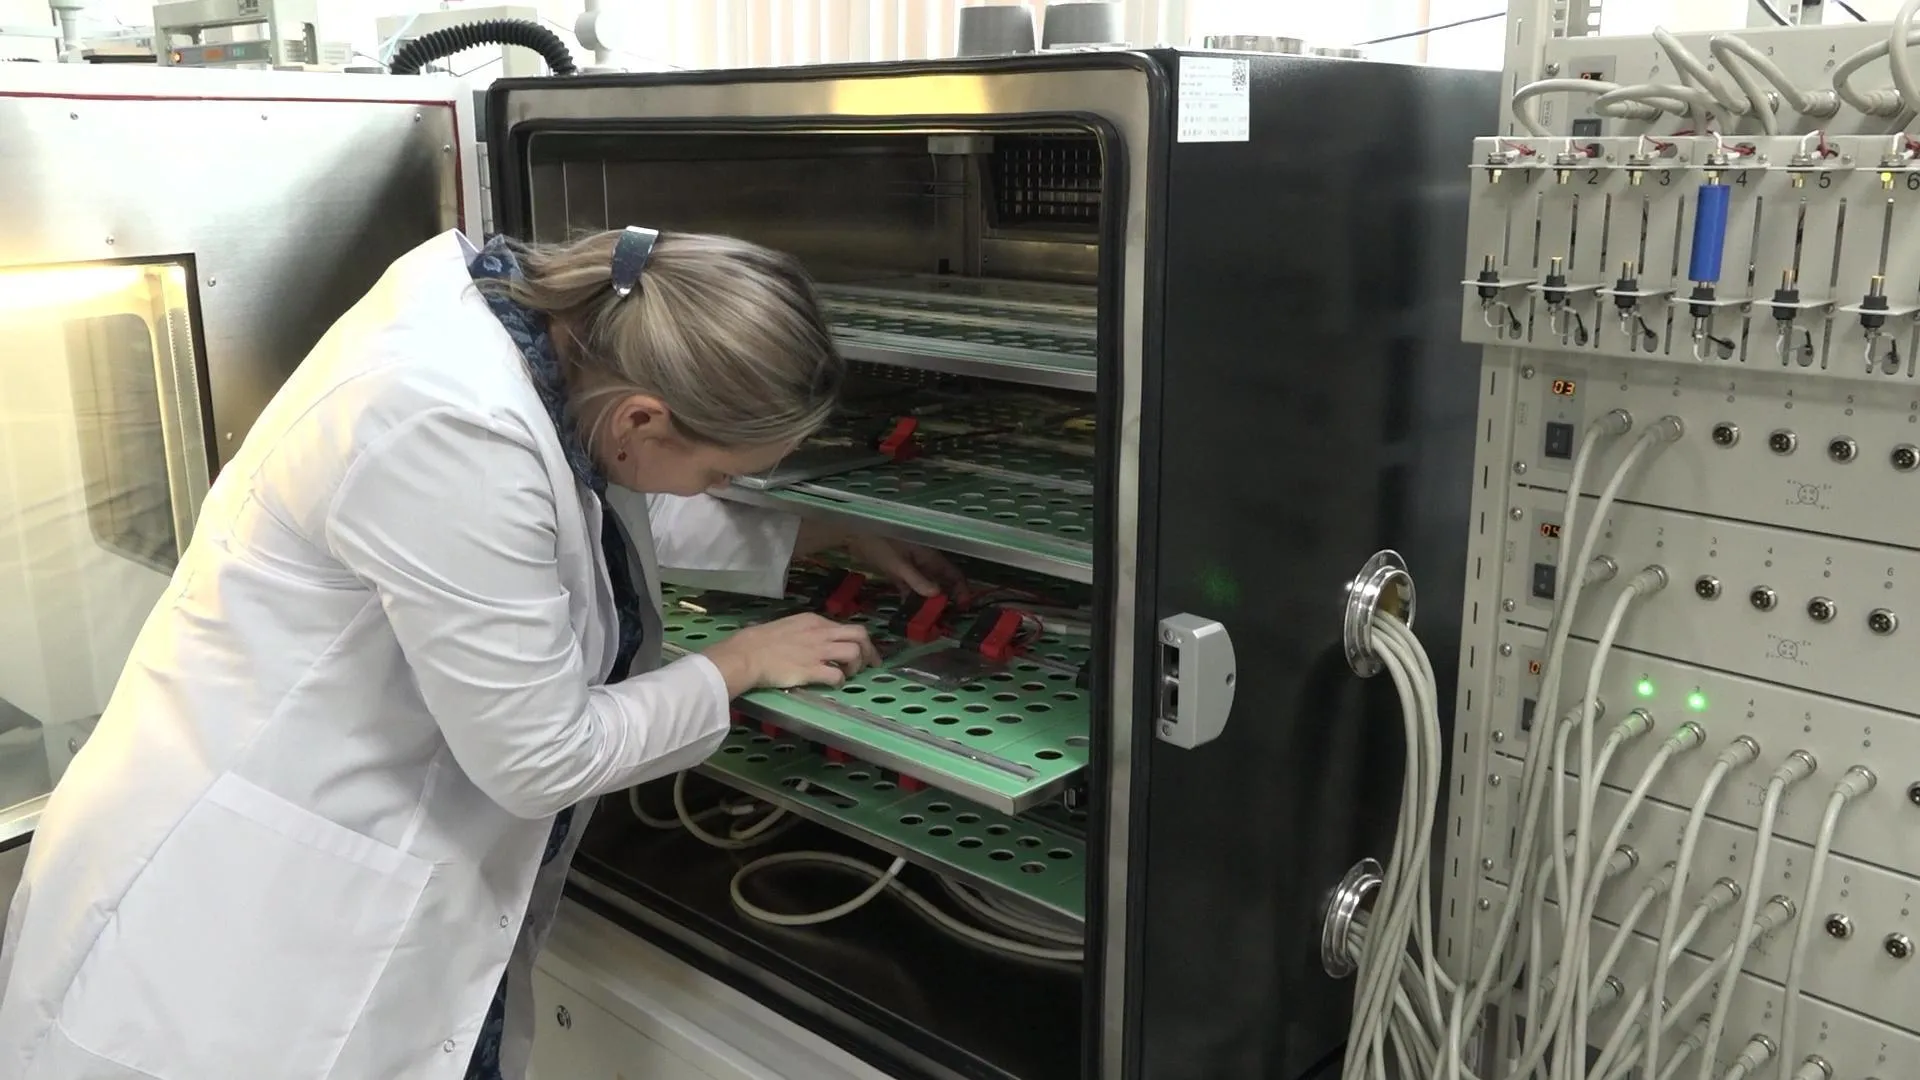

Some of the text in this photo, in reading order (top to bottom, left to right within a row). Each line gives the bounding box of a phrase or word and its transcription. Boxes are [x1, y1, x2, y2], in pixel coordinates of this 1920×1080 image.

[1767, 46, 1774, 56] 3
[1829, 44, 1836, 53] 4
[1524, 169, 1920, 190] 1 2 3 4 5 6
[1554, 380, 1575, 395] 03
[1673, 376, 1682, 385] 2
[1847, 394, 1854, 404] 5
[1910, 400, 1919, 411] 6
[1657, 526, 1664, 536] 2
[1711, 536, 1717, 545] 3
[1766, 546, 1773, 555] 4
[1824, 556, 1832, 566] 5
[1887, 566, 1895, 577] 6
[1863, 726, 1871, 736] 6
